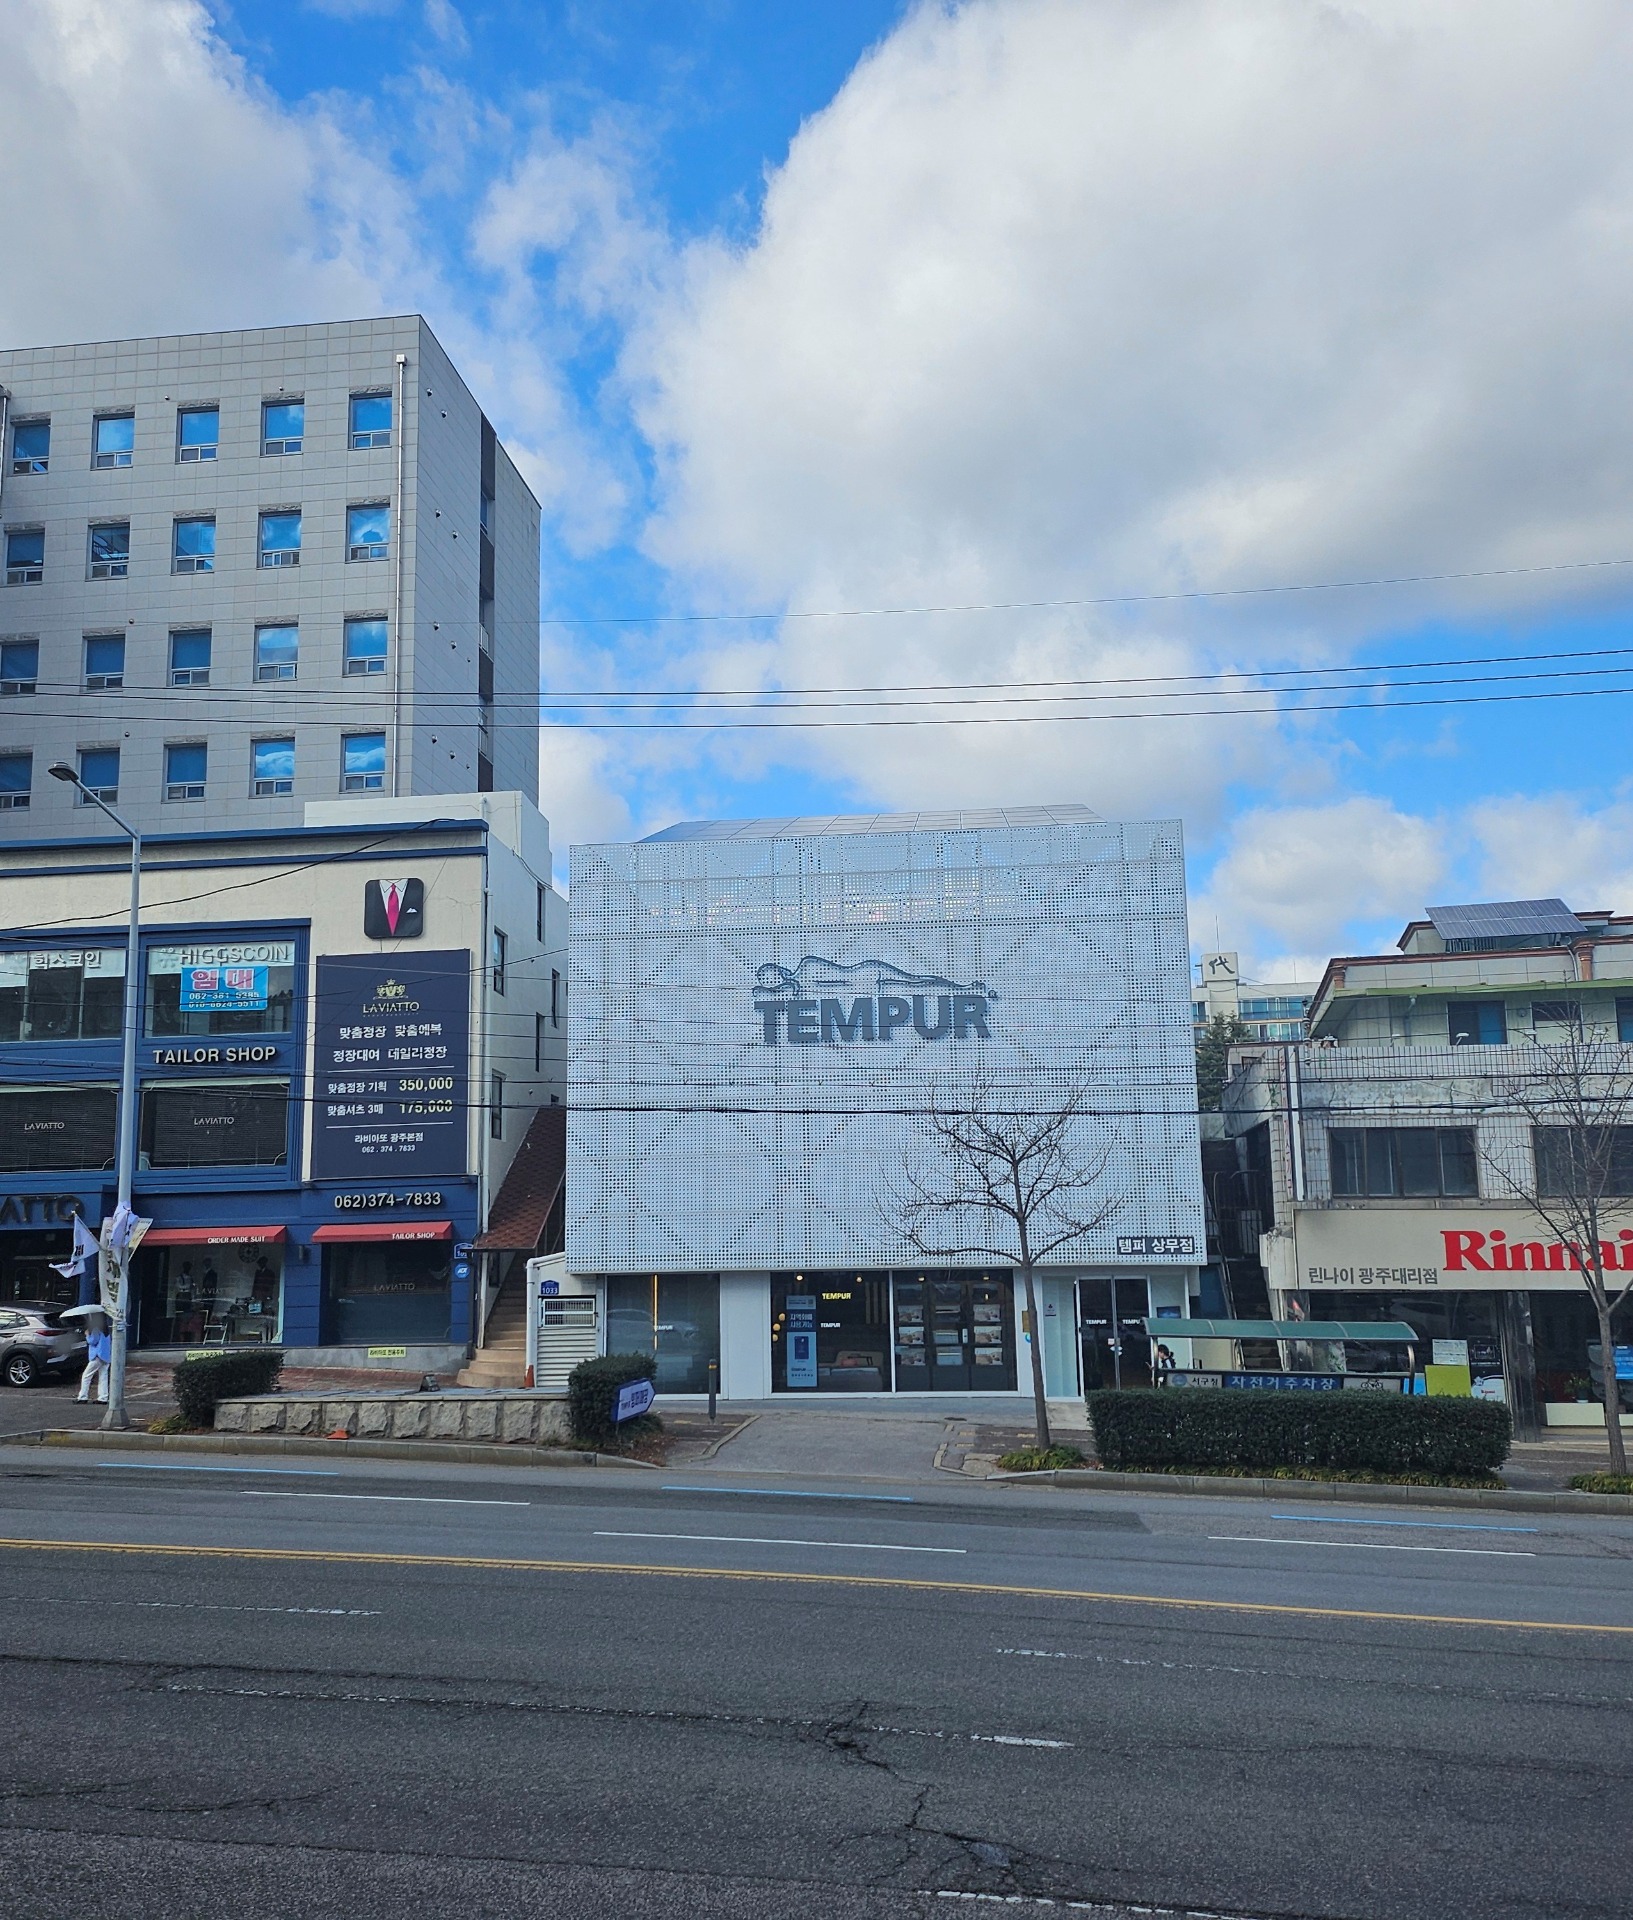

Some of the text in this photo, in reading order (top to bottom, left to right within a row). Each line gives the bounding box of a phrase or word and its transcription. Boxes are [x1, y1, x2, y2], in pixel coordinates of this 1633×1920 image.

[180, 945, 289, 965] HIGGSCOIN
[1208, 956, 1235, 975] 代
[754, 995, 991, 1043] TEMPUR
[339, 1026, 387, 1040] 맞춤정장
[153, 1046, 276, 1064] TAILOR SHOP
[333, 1046, 447, 1063] 정장대여 데일리정장
[328, 1076, 453, 1094] 맞춤정장 기획 350,000
[327, 1104, 366, 1116] 맞춤셔츠
[399, 1099, 453, 1114] 175,000
[354, 1132, 424, 1144] 라비아또 광주본점
[334, 1191, 441, 1209] 062)374-7833
[207, 1235, 265, 1244] ORDER MADE SUIT
[391, 1231, 435, 1240] TAILOR SHOP
[1118, 1238, 1193, 1253] 템퍼 상무점
[1440, 1229, 1633, 1271] Rinnai
[1308, 1267, 1438, 1285] 린나이 광주대리점
[542, 1287, 558, 1295] 1033
[822, 1292, 852, 1300] TEMPUR
[1192, 1377, 1219, 1387] 서구청
[1231, 1376, 1336, 1391] 자전거주차장
